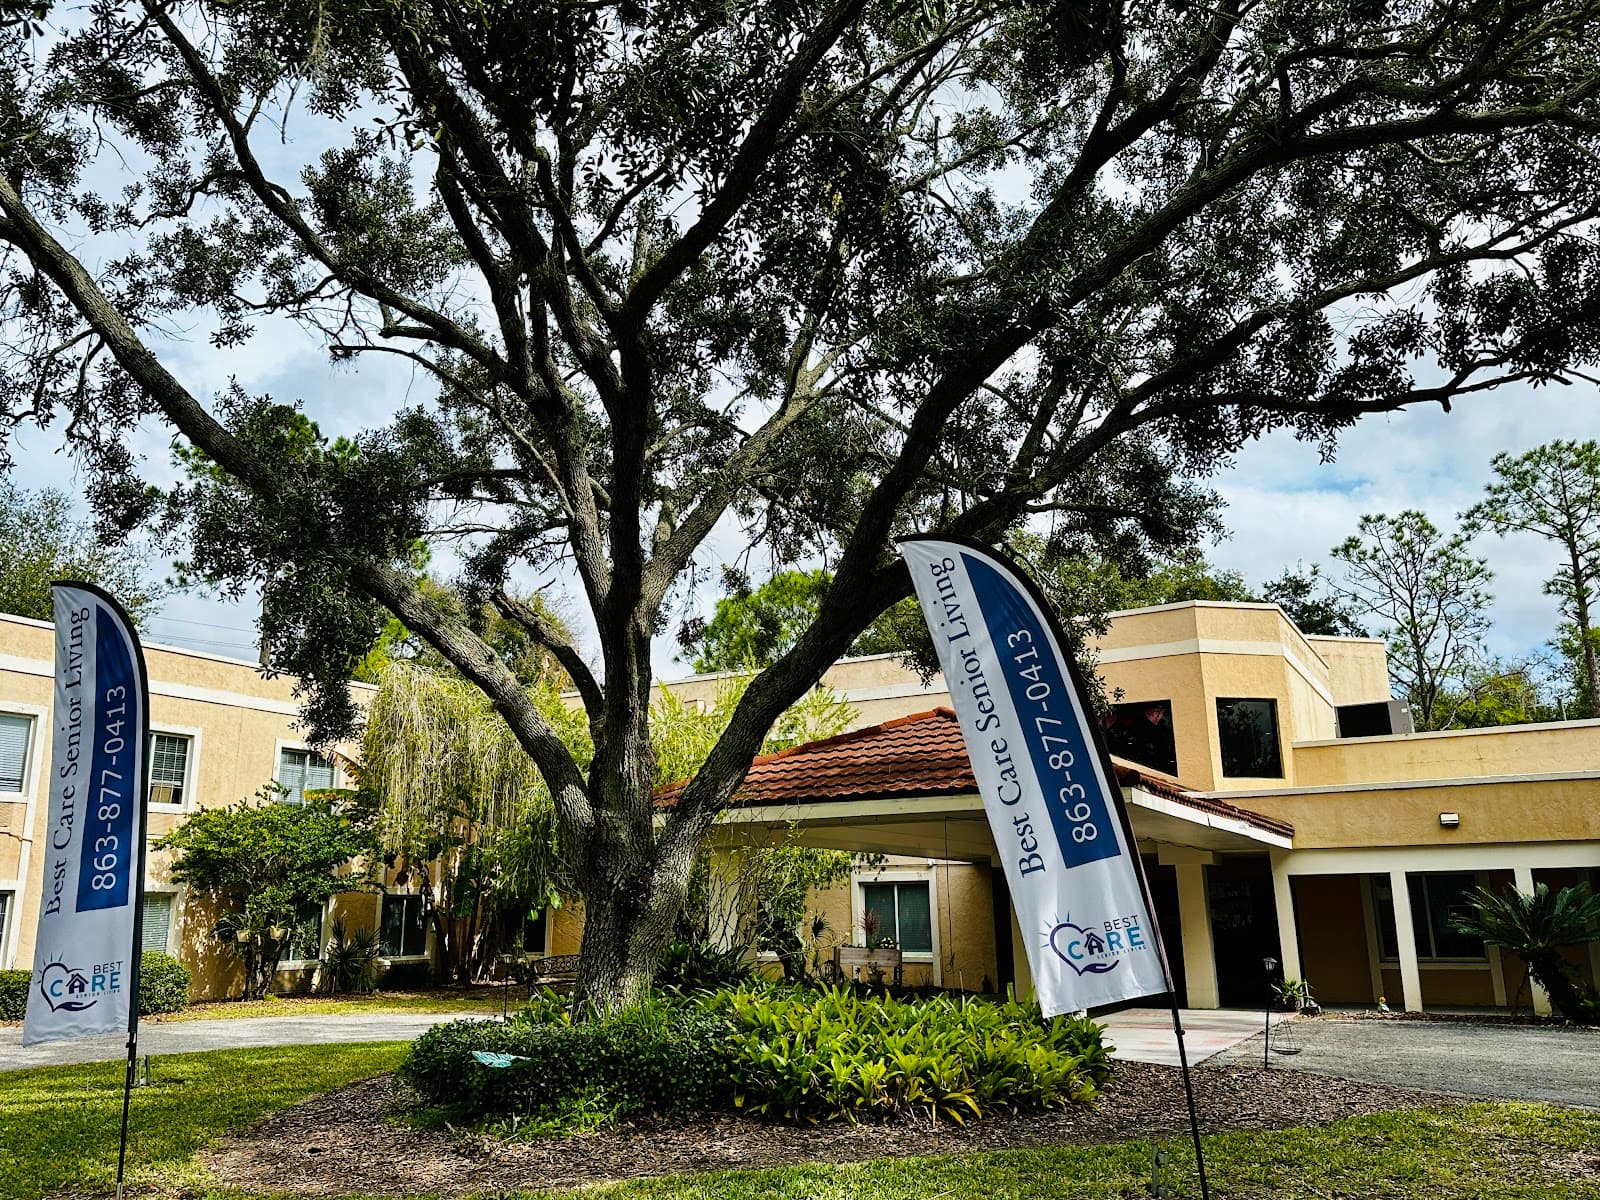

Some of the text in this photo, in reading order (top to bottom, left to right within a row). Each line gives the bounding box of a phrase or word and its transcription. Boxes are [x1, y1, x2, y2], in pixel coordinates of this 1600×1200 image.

[44, 607, 90, 918] Best Care Senior Living
[930, 557, 1046, 878] Best Care Senior Living
[1007, 629, 1098, 843] 863-877-0413
[91, 685, 126, 890] 863-877-0413
[93, 961, 124, 975] BEST
[1068, 926, 1144, 960] CARE
[1103, 915, 1138, 931] BEST
[50, 971, 121, 998] CARE
